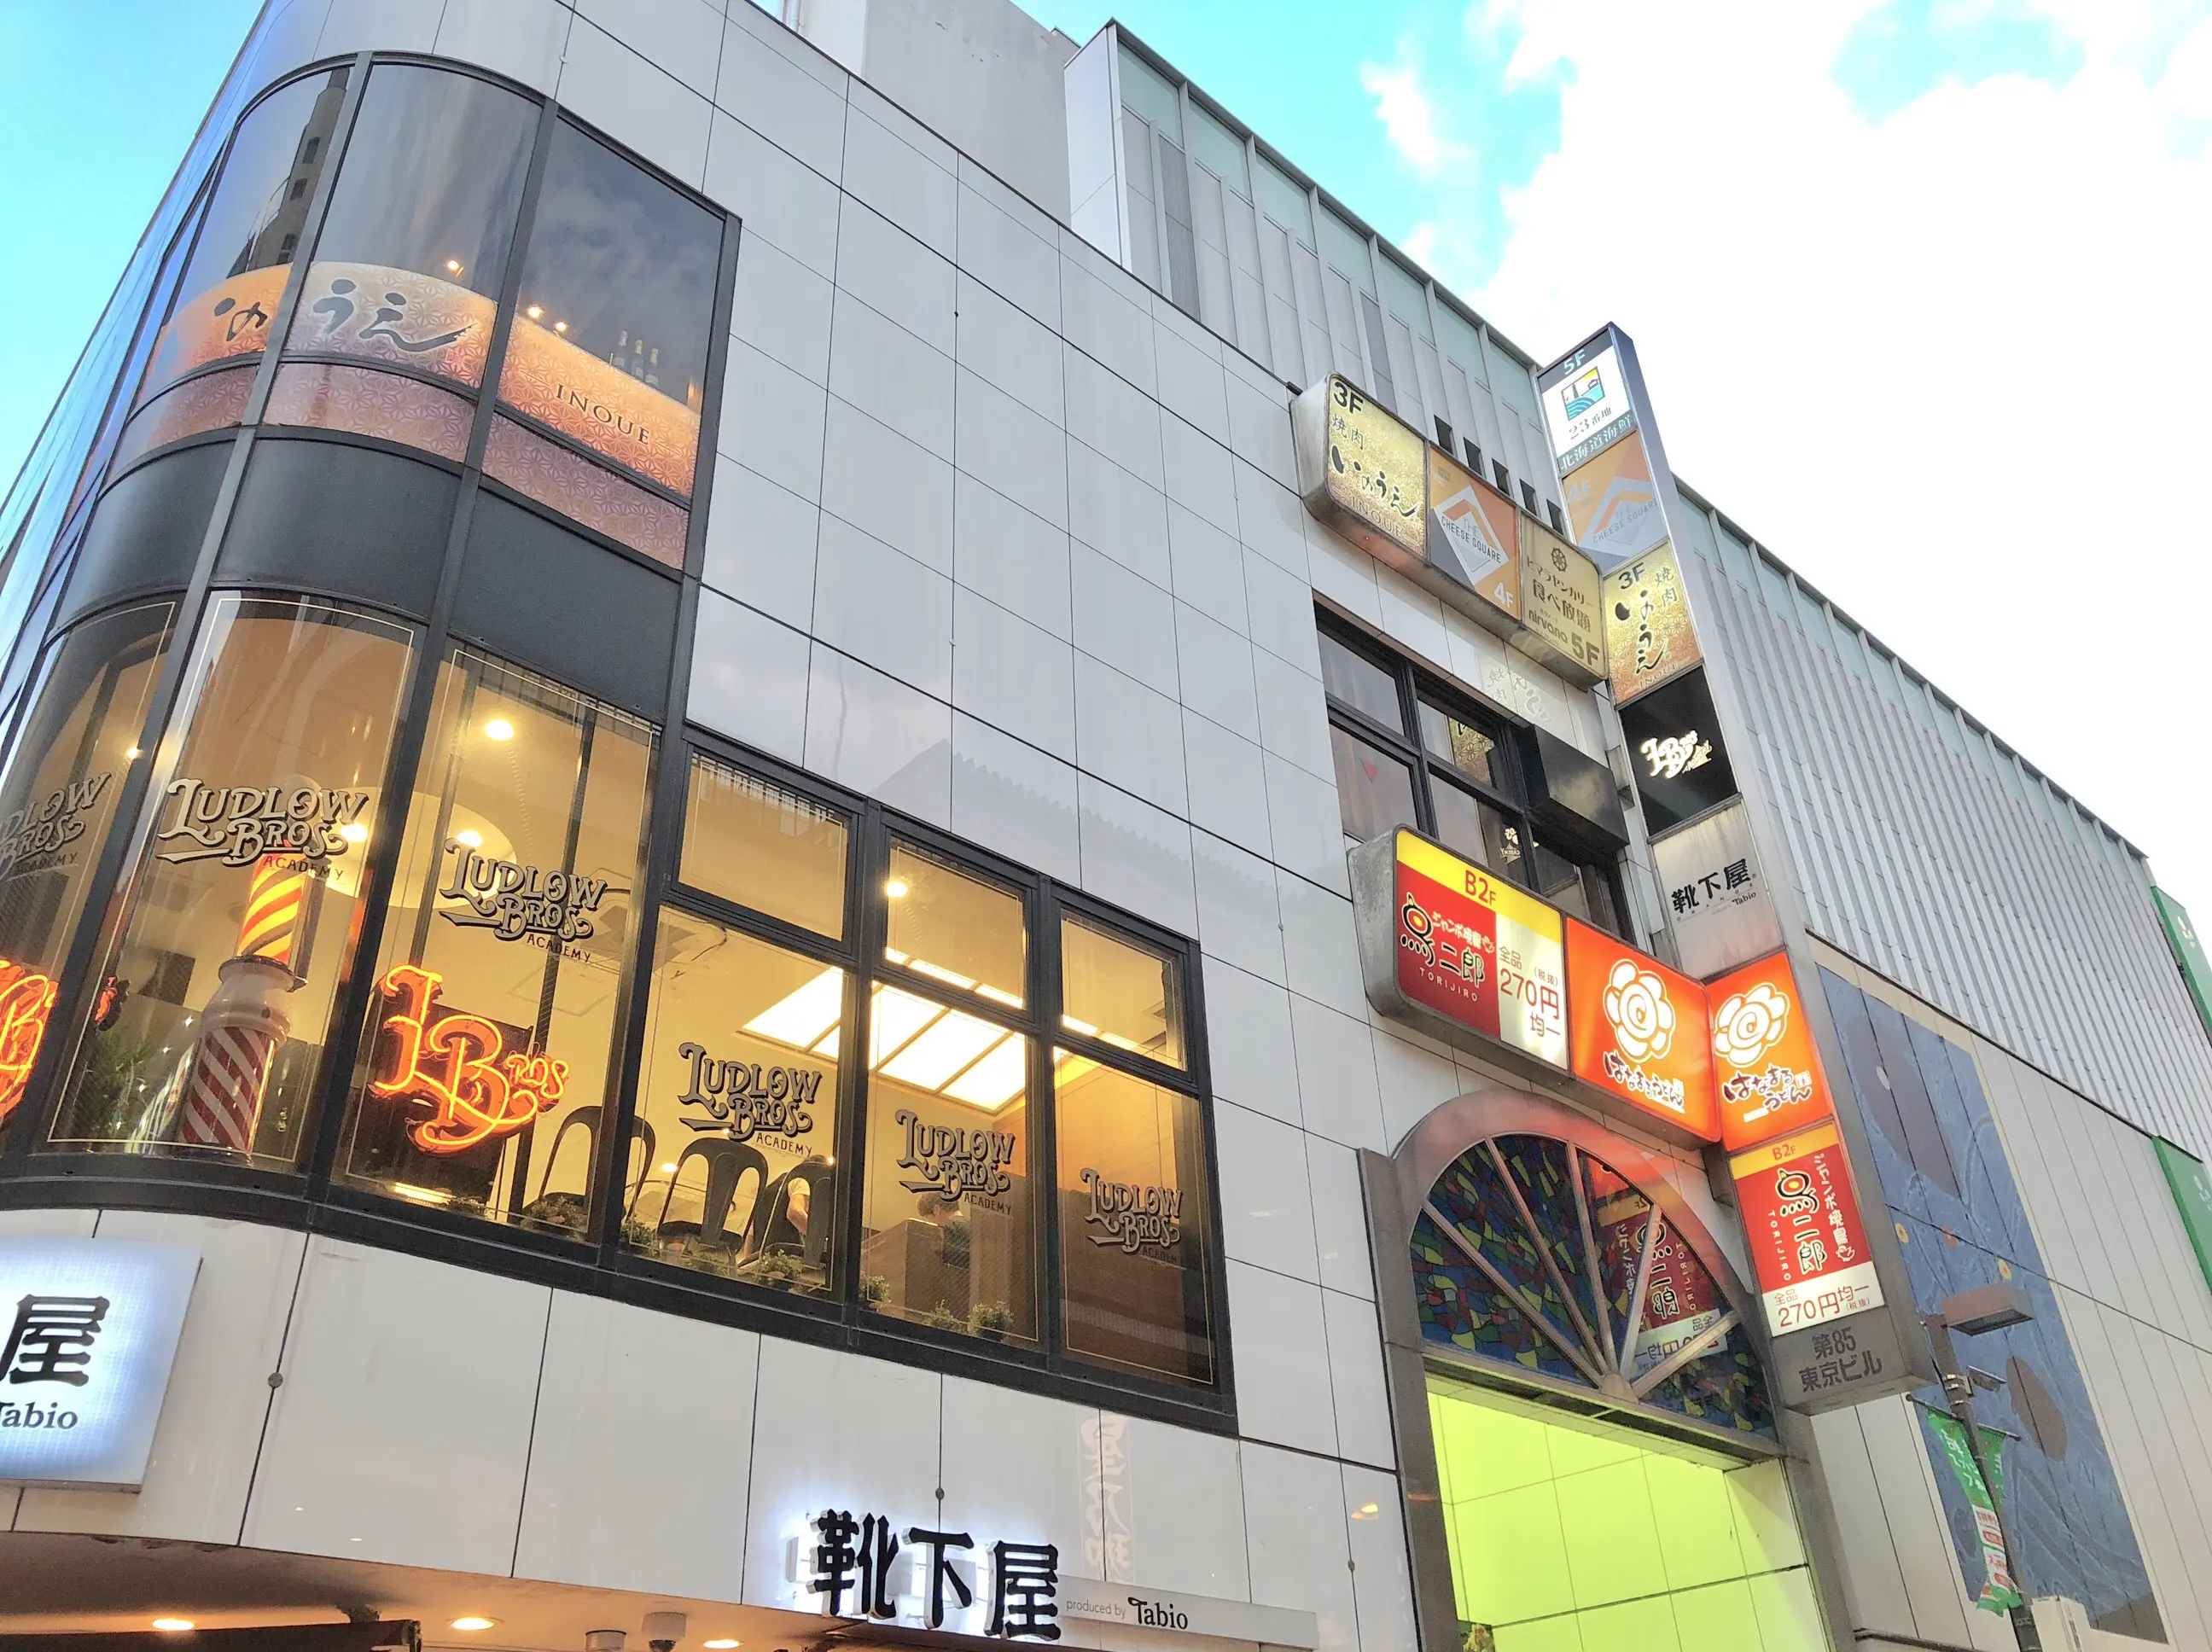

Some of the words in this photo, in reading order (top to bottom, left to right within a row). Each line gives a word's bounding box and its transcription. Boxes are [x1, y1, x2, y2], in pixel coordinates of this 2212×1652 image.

[1563, 348, 1587, 375] 5F
[555, 382, 651, 446] INOUE
[1333, 381, 1364, 415] 3F
[1331, 413, 1365, 451] 焼肉
[1351, 495, 1403, 539] INOUE
[1592, 519, 1626, 544] CHEESE
[1627, 497, 1659, 524] SQUARE
[1441, 515, 1470, 544] CHEESE
[1471, 540, 1502, 565] SQUARE
[1493, 582, 1514, 608] 4F
[1527, 556, 1593, 608] ヒマラヤンカリー
[1618, 562, 1646, 590] 3F
[1654, 566, 1678, 607] 焼肉
[1533, 579, 1592, 633] 食べ放題
[1528, 609, 1569, 644] nirvana
[1571, 631, 1600, 666] 5F
[157, 777, 370, 847] LUDLOW
[263, 856, 344, 880] ACADEMY
[439, 837, 608, 917] LUDLOW
[1465, 870, 1497, 906] B2F
[1671, 858, 1751, 914] 靴下屋
[1732, 892, 1756, 906] Tabio
[527, 934, 591, 963] ACADEMY
[1432, 910, 1483, 950] ジャンボ焼鳥
[1499, 945, 1522, 970] 全品
[1419, 967, 1478, 1002] TORIJIRO
[1499, 968, 1560, 1021] 270円
[677, 1042, 824, 1120] LUDLOW
[1603, 1049, 1685, 1108] はなまるうどん
[756, 1132, 812, 1157] ACADEMY
[895, 1109, 1016, 1181] LUDLOW
[1773, 1143, 1796, 1160] B2F
[963, 1192, 1012, 1215] ACADEMY
[1080, 1167, 1185, 1236] LUDLOW
[1813, 1153, 1848, 1247] ジャンボ焼鳥
[1143, 1246, 1185, 1266] ACADEM
[1768, 1209, 1792, 1282] TORIJIRO
[1774, 1288, 1798, 1306] 全品
[1778, 1284, 1870, 1328] 270円均一
[0, 1294, 110, 1387] 屋
[1812, 1326, 1857, 1360] 第85
[1799, 1350, 1883, 1393] 東京ビル
[812, 1509, 1062, 1642] 靴下屋
[1067, 1598, 1112, 1614] produced
[1115, 1603, 1126, 1620] by
[1127, 1597, 1189, 1630] Tabio
